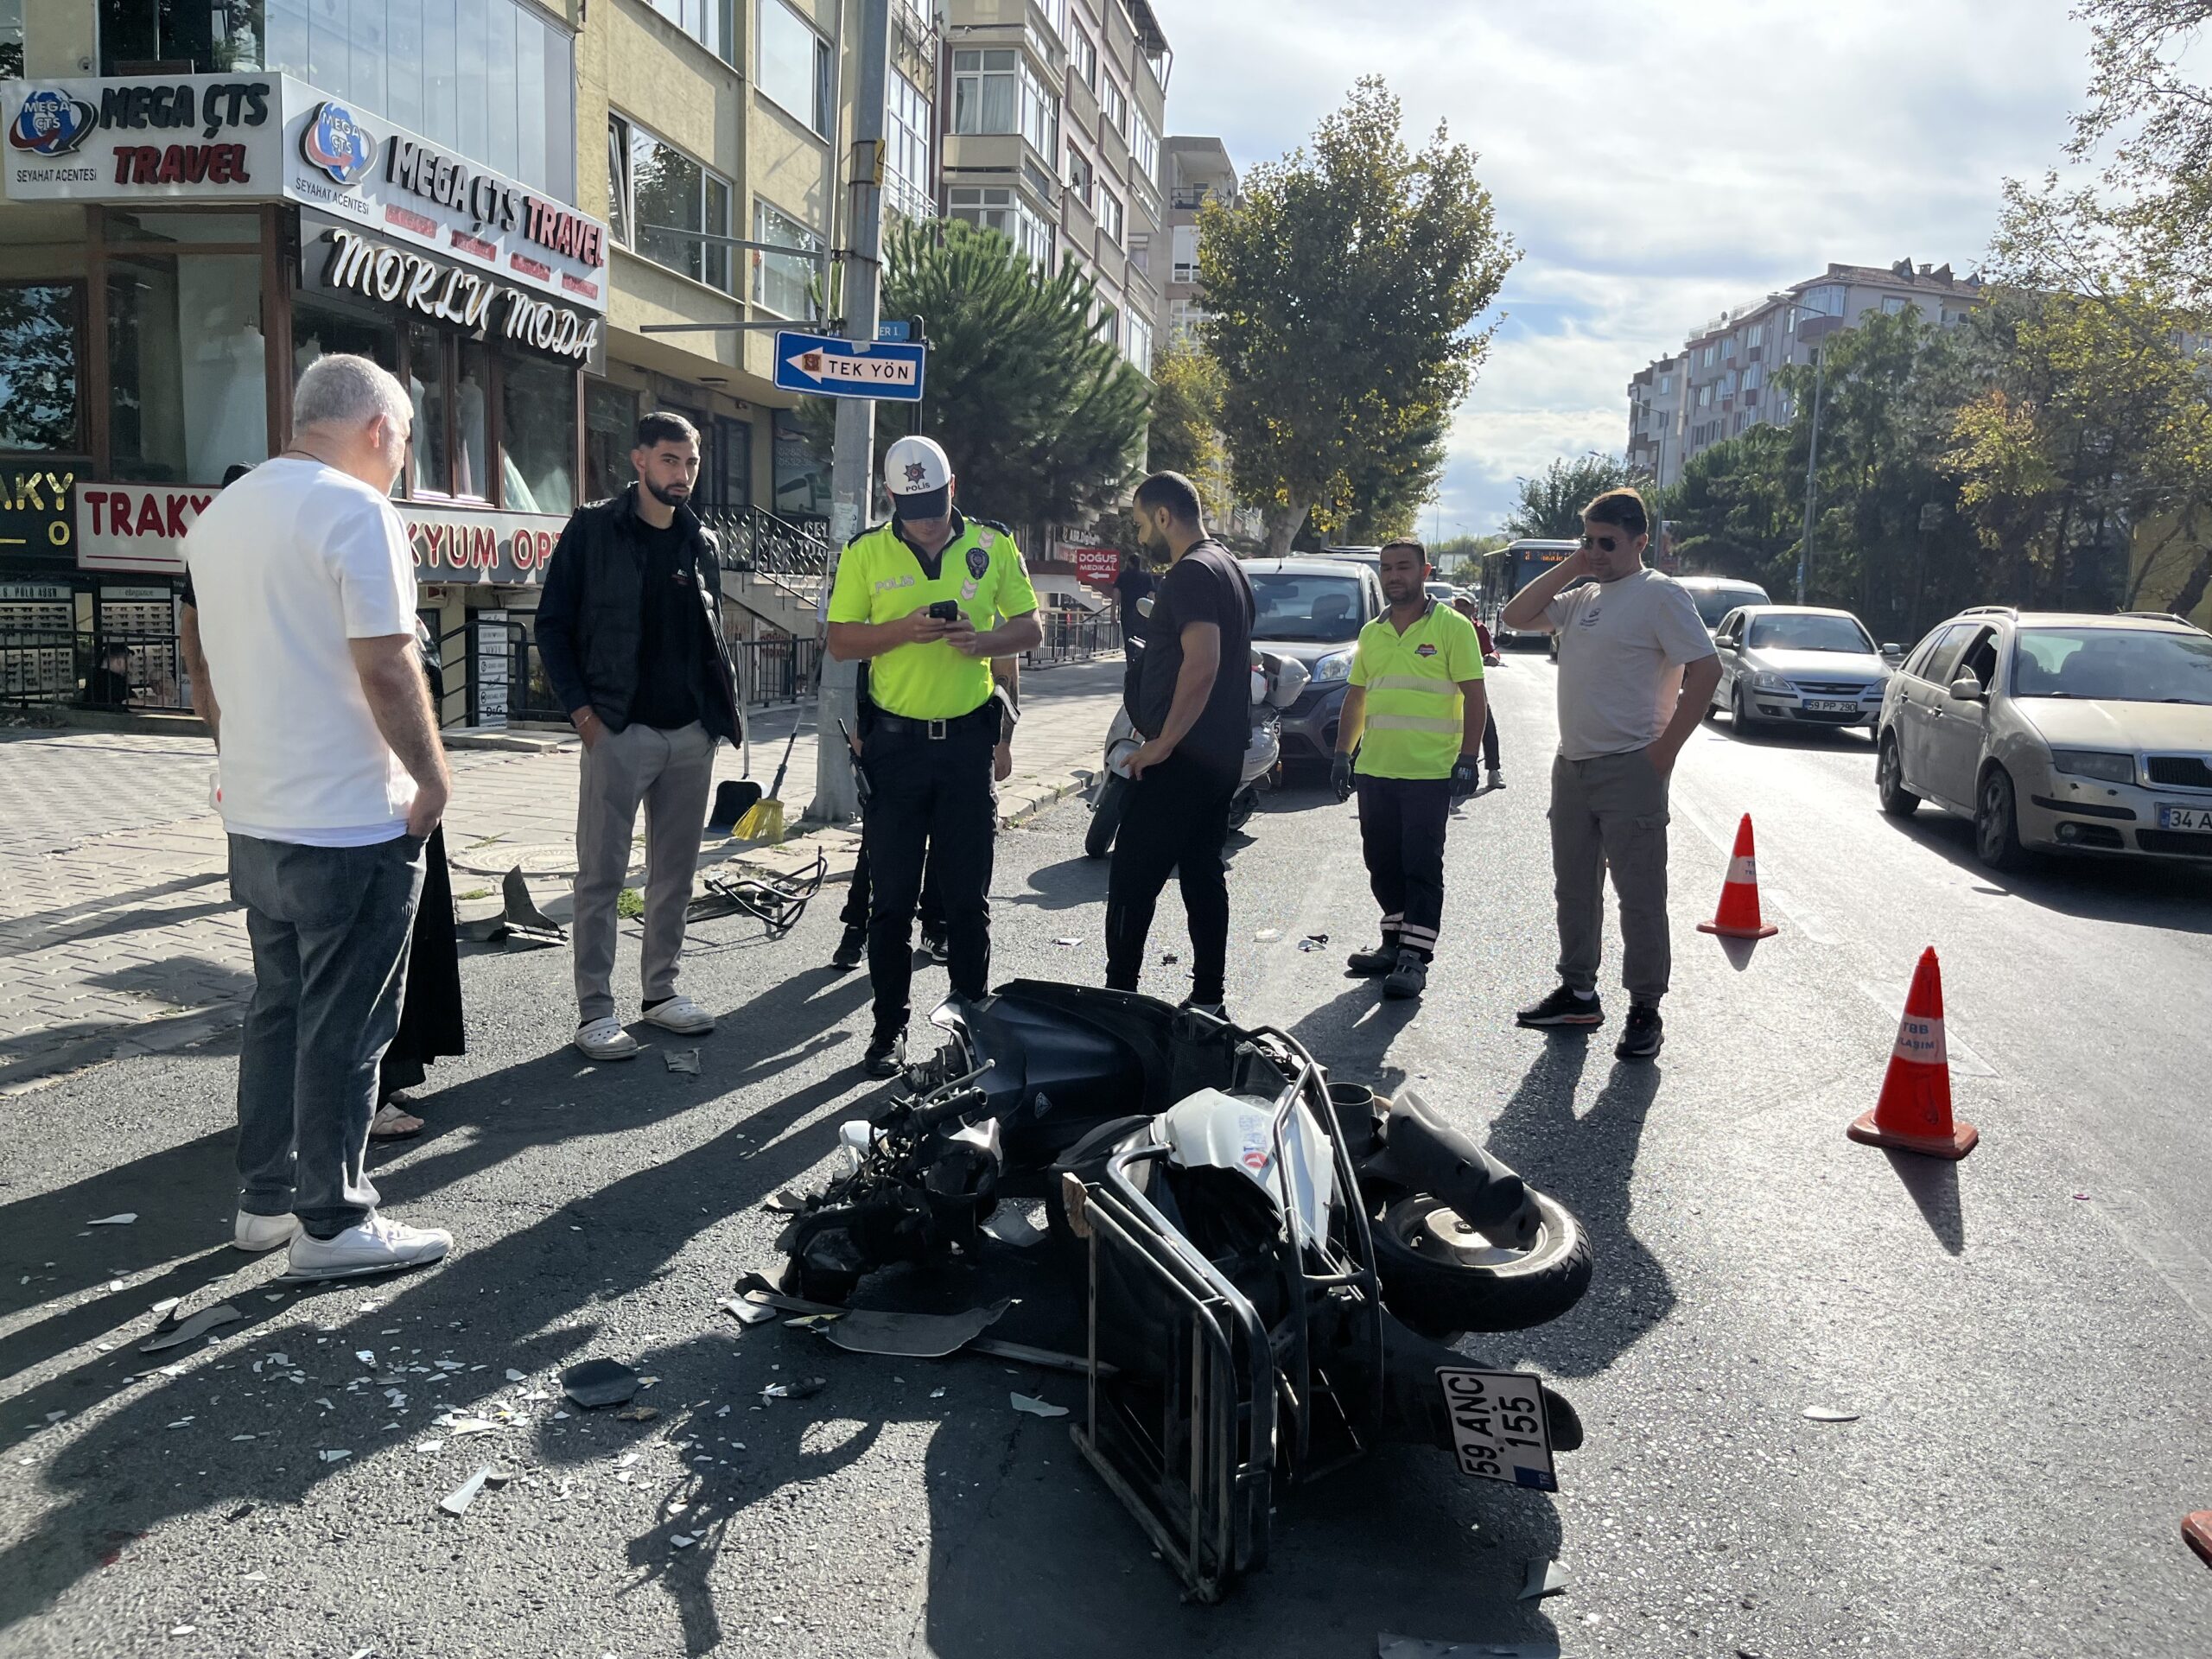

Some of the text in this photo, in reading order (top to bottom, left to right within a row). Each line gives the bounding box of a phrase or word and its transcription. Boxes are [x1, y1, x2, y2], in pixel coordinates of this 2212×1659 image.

[23, 99, 70, 113] MEGA
[99, 83, 270, 139] MEGA ÇTS
[321, 111, 360, 137] MEGA
[112, 143, 251, 185] TRAVEL
[16, 169, 54, 183] SEYAHAT
[296, 177, 332, 200] SEYAHAT
[386, 135, 469, 213] MEGA
[471, 175, 520, 232] ÇTS
[524, 195, 604, 268] TRAVEL
[505, 287, 599, 364] MODA
[829, 360, 908, 379] TEK YÖN
[906, 481, 931, 493] POLİS
[874, 574, 916, 595] POLİS
[1809, 701, 1855, 712] 59 PP 290
[2171, 810, 2192, 828] 34
[1903, 1022, 1929, 1034] TBB
[1447, 1376, 1502, 1475] 59 ANC
[1497, 1395, 1541, 1448] 155
[1538, 1474, 1551, 1485] TR
